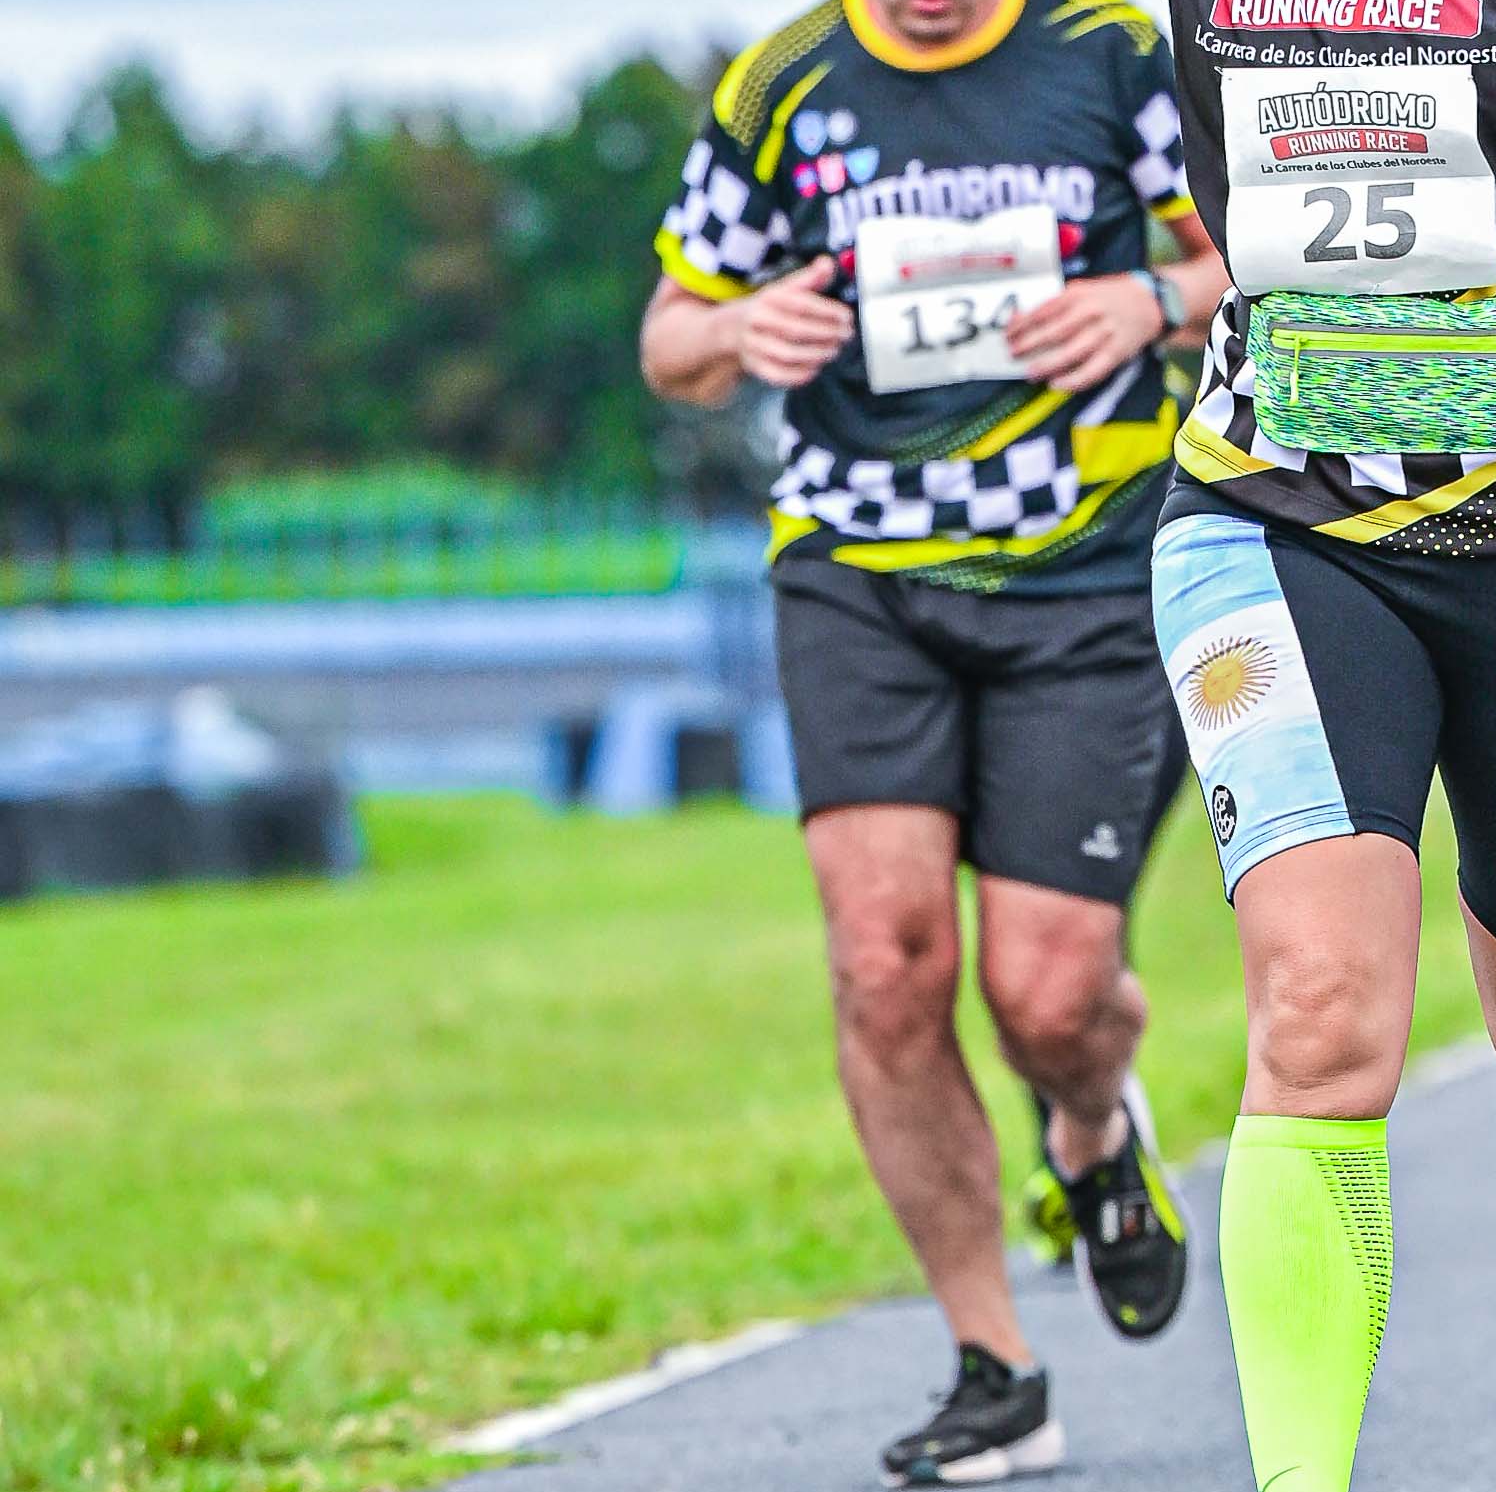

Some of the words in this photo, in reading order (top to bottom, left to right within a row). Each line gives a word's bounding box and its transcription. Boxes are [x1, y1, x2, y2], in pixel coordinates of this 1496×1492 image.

[1203, 31, 1256, 61] Carrera
[1261, 43, 1284, 64] de
[1288, 44, 1314, 65] los
[1319, 46, 1377, 67] Clubes
[1381, 46, 1412, 66] del
[1258, 82, 1436, 134] AUTÓDROMO
[1287, 131, 1361, 156] RUNNING
[1366, 132, 1409, 151] RACE
[1261, 164, 1274, 174] La
[1276, 164, 1313, 173] Carrera
[1315, 161, 1328, 171] de
[1330, 161, 1345, 170] los
[1347, 159, 1382, 169] Clubes
[1384, 158, 1400, 168] del
[1401, 157, 1447, 167] Noroeste
[1303, 182, 1417, 263] 25
